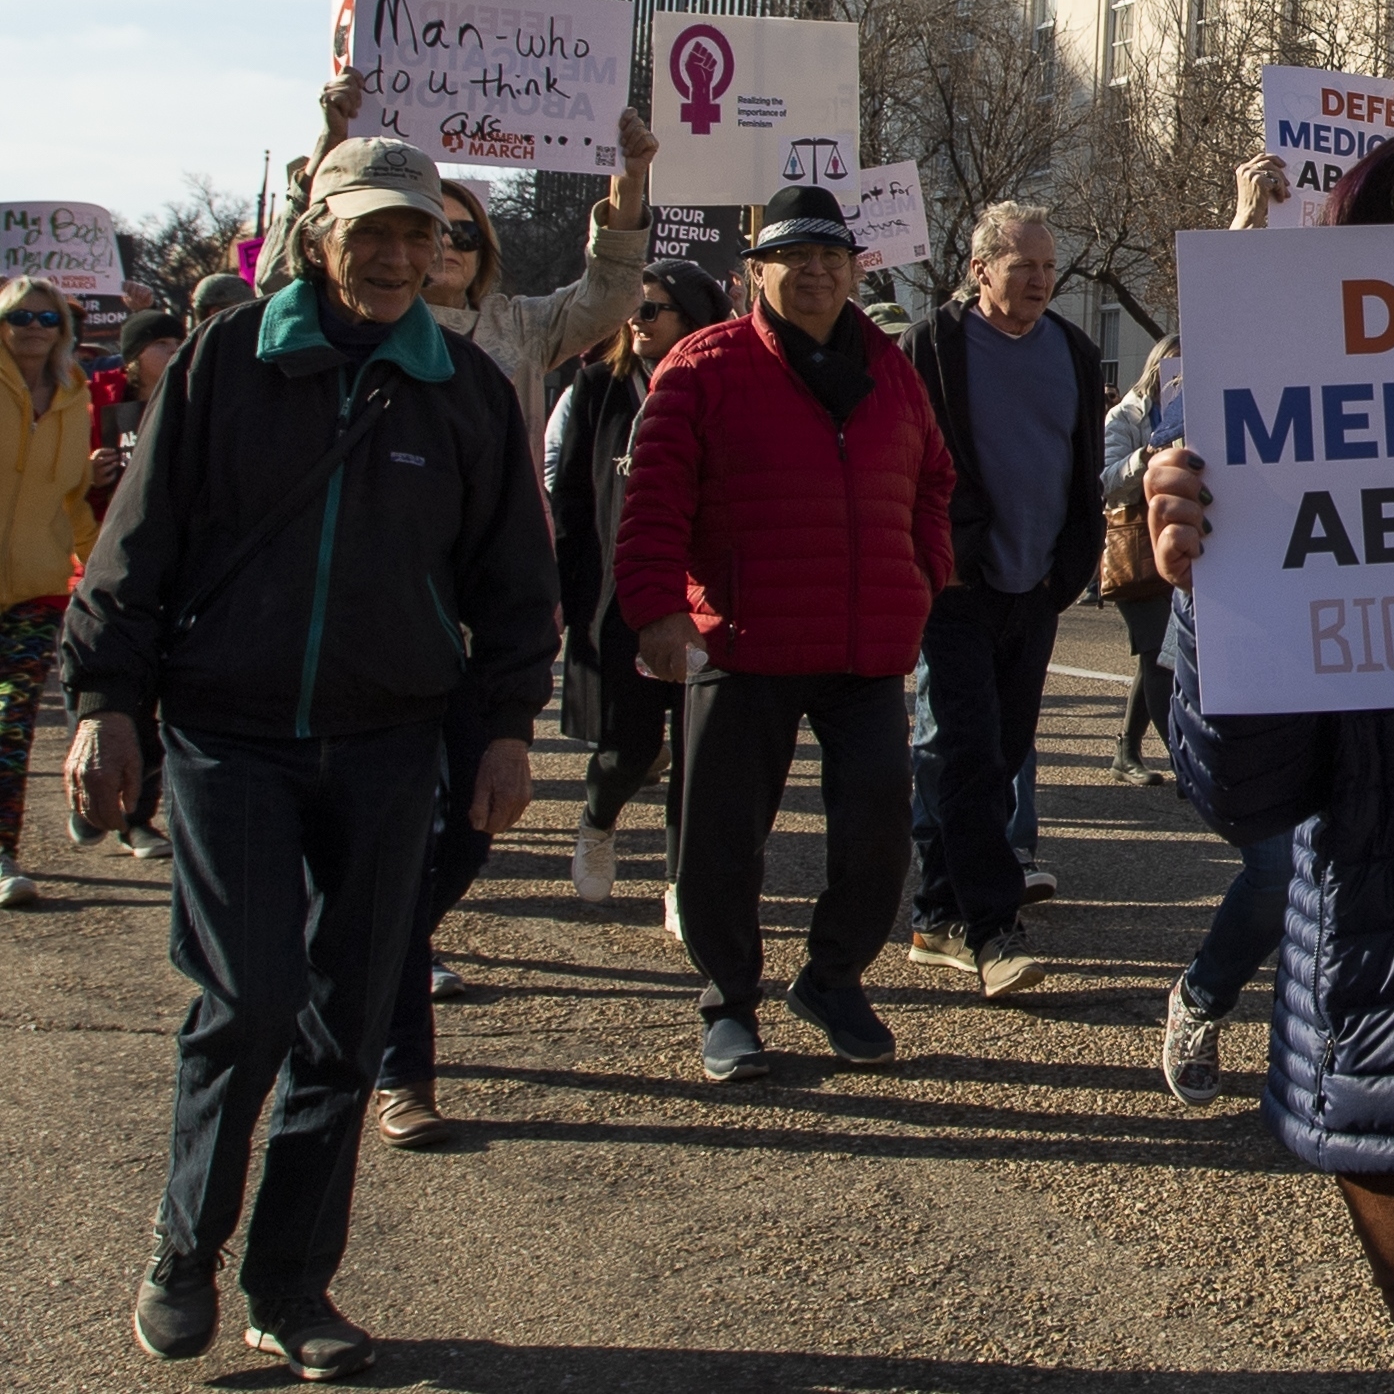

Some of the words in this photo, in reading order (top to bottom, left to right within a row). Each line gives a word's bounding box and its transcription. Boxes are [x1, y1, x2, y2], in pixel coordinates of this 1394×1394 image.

[363, 54, 411, 95] do
[428, 69, 458, 96] u
[469, 62, 571, 100] think
[737, 95, 770, 107] Realizing
[771, 97, 784, 106] the
[381, 107, 410, 138] u
[737, 107, 779, 119] Importance
[779, 108, 787, 117] of
[737, 119, 773, 128] Feminism
[468, 142, 535, 161] MARCH
[889, 181, 914, 200] for
[659, 206, 705, 224] YOUR
[4, 209, 42, 246] My
[656, 223, 720, 243] UTERUS
[846, 219, 911, 236] uture
[654, 239, 690, 257] NOT
[5, 245, 42, 276] My
